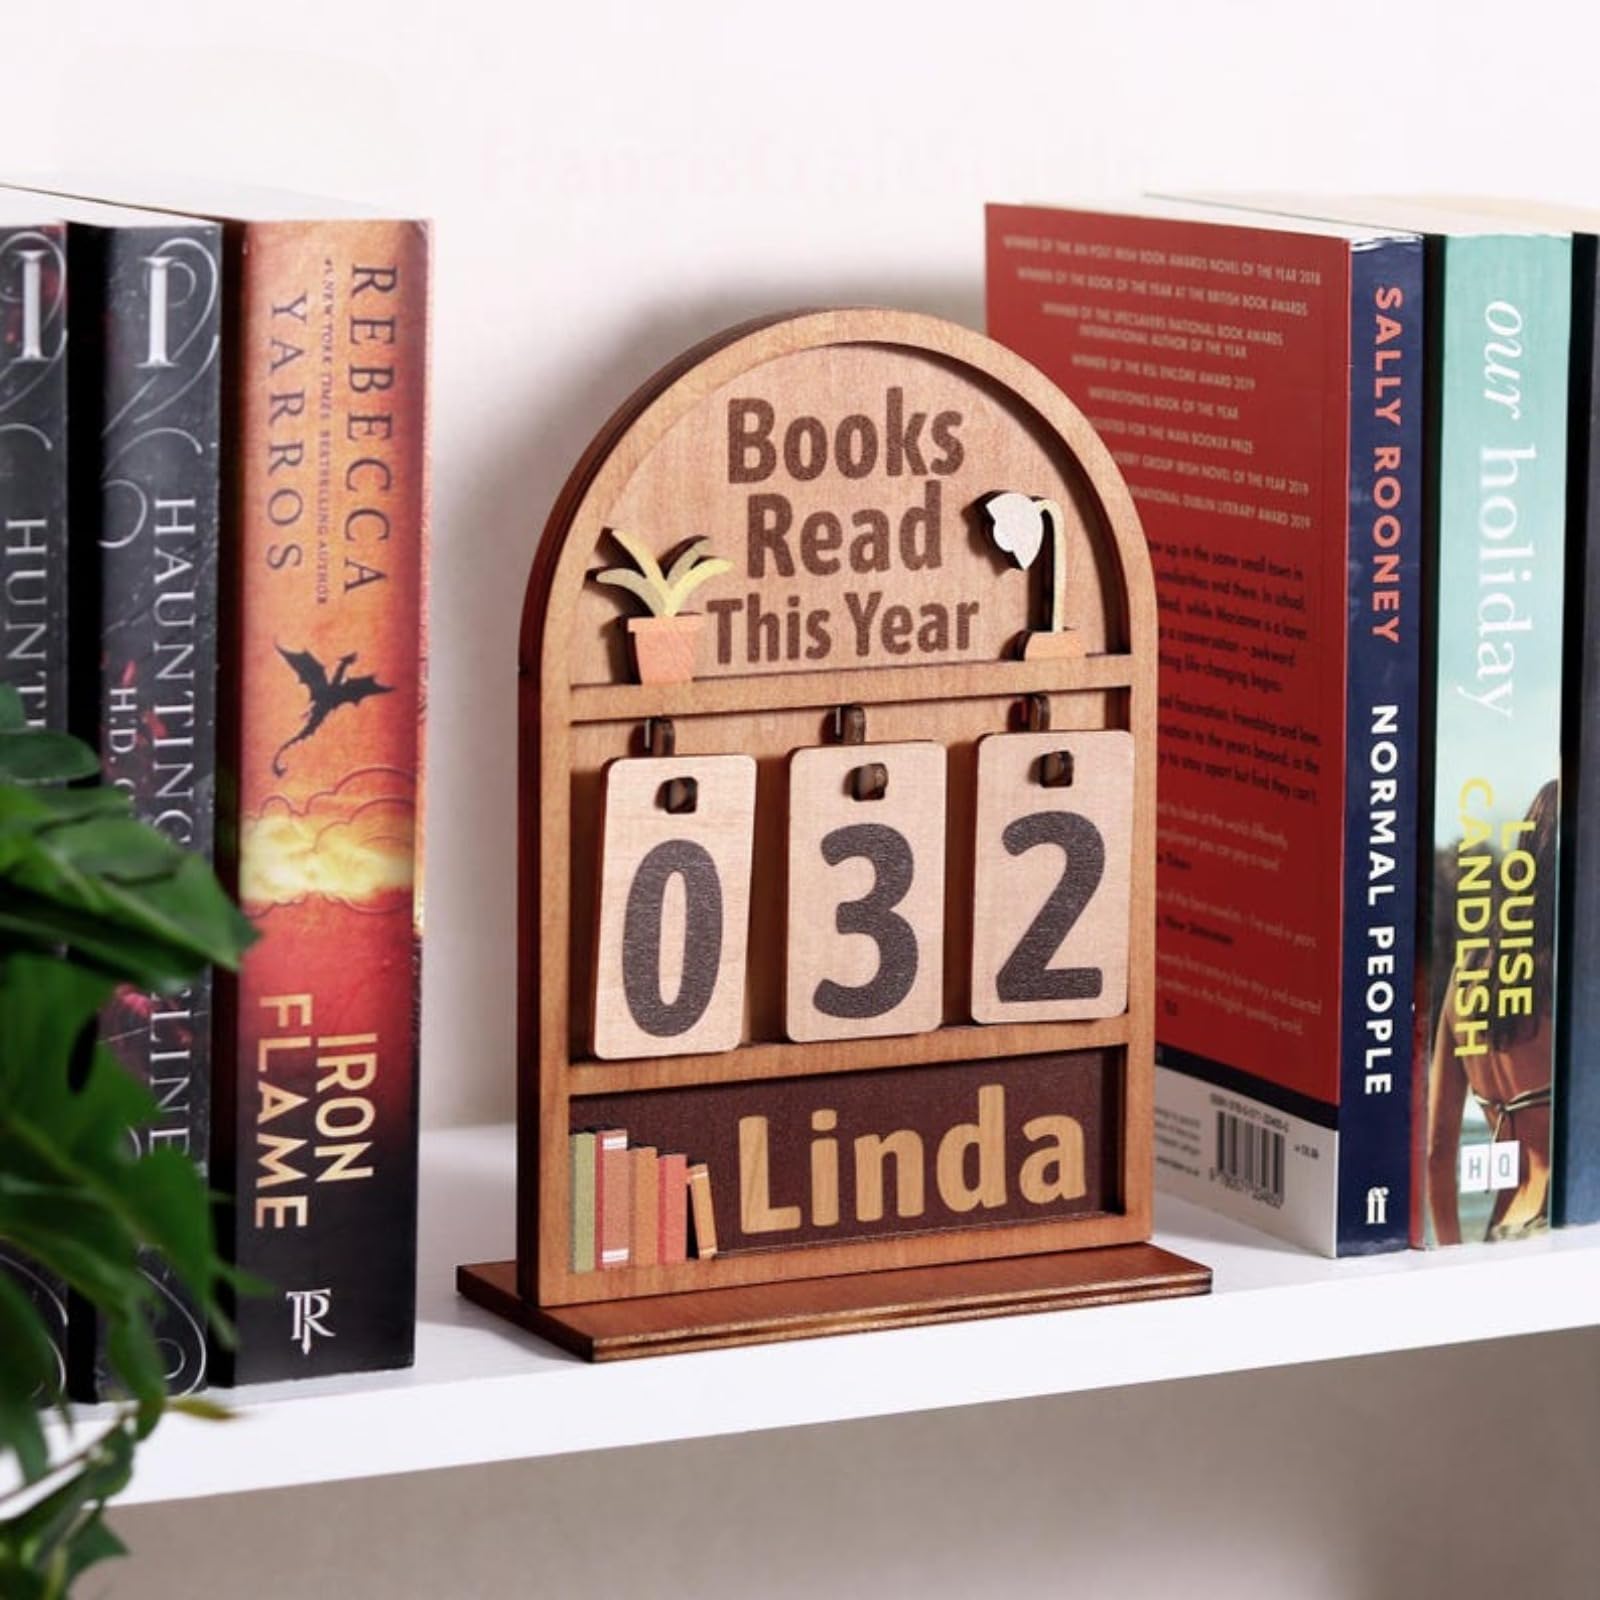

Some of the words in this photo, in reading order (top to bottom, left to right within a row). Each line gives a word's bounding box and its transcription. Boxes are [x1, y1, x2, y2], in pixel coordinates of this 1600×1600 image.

[1169, 255, 1207, 272] AWARDS
[1210, 259, 1239, 276] NOVEL
[1242, 263, 1253, 278] OF
[1257, 265, 1272, 280] THE
[1275, 267, 1297, 283] YEAR
[1373, 286, 1404, 425] SALLY
[1484, 300, 1524, 420] our
[266, 291, 308, 571] YARROS
[344, 264, 398, 594] REBECCA
[728, 383, 965, 484] Books
[747, 480, 942, 579] Read
[1372, 447, 1401, 644] ROONEY
[1457, 442, 1538, 718] holiday
[706, 592, 832, 665] This
[843, 591, 980, 657] Year
[1366, 705, 1398, 906] NORMAL
[622, 839, 723, 1038] 0
[812, 823, 919, 1019] 3
[995, 811, 1105, 1003] 2
[1452, 778, 1493, 1058] CANDLISH
[1497, 819, 1537, 1019] LOUISE
[1364, 926, 1395, 1095] PEOPLE
[255, 993, 314, 1229] FLAME
[314, 1032, 379, 1182] IRON
[738, 1084, 1087, 1234] Linda
